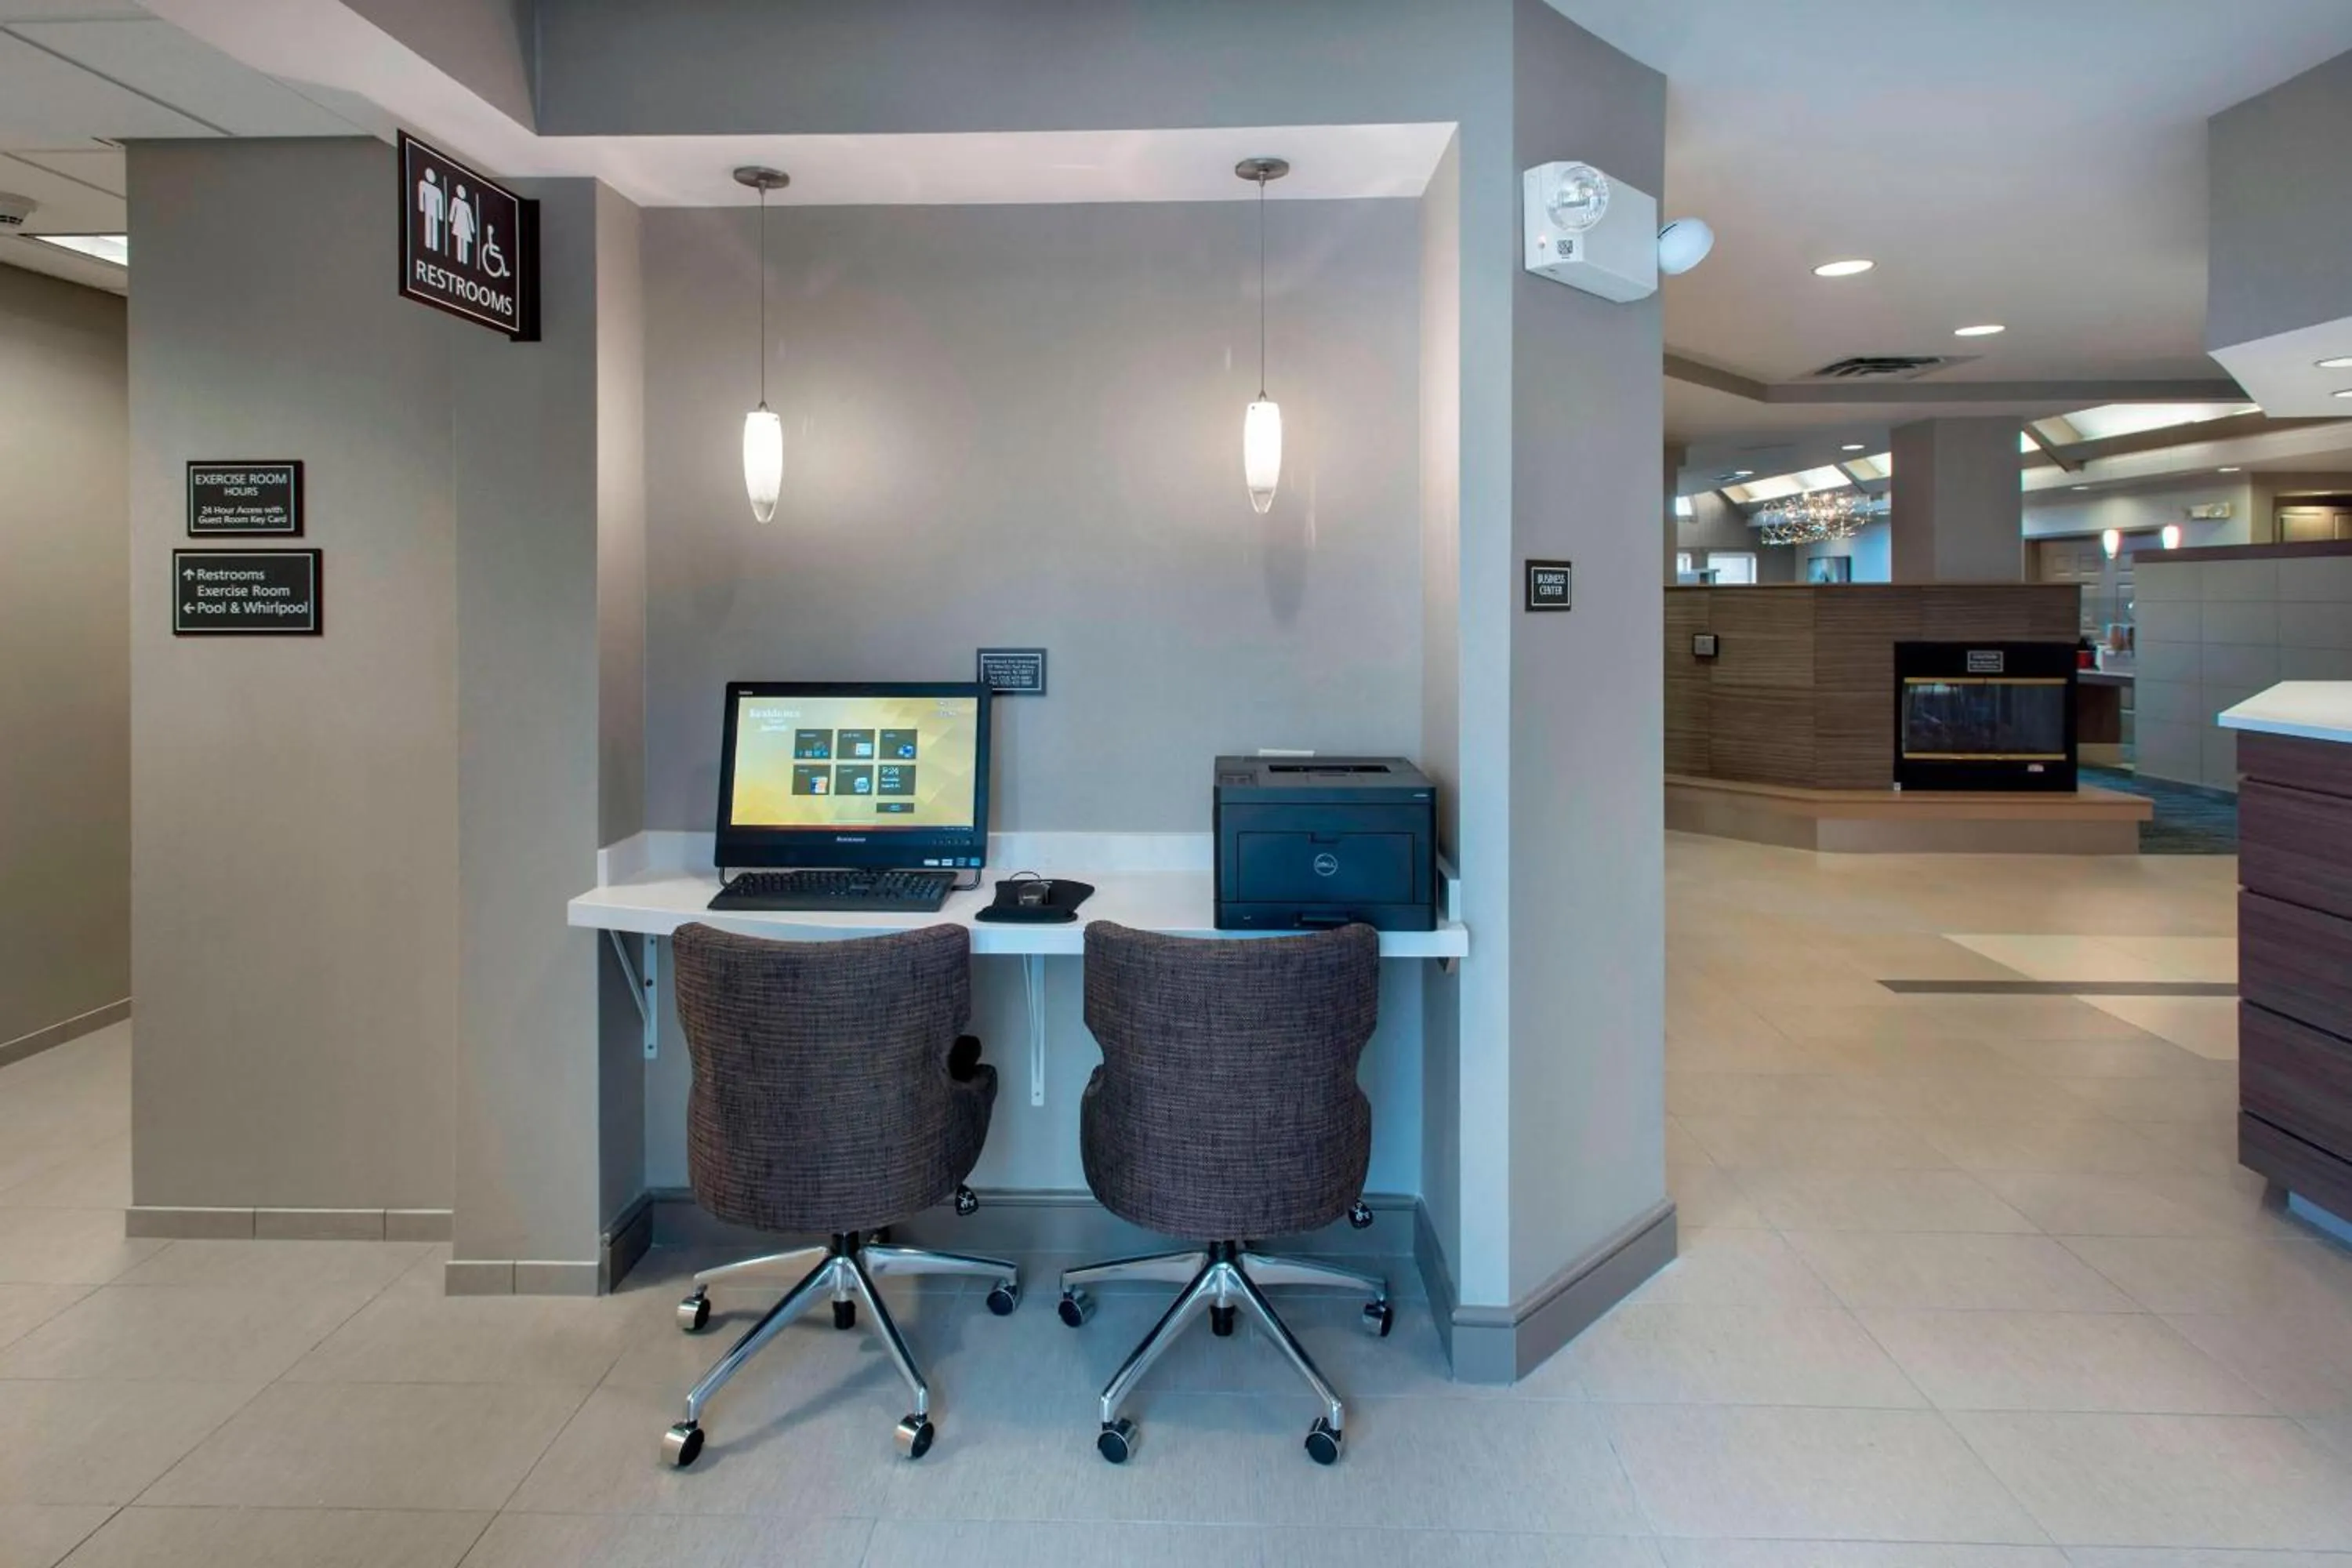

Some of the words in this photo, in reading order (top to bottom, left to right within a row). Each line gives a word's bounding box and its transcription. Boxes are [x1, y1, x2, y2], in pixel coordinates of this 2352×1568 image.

[416, 260, 513, 315] RESTROOMS
[195, 474, 247, 485] EXERCISE
[249, 474, 288, 485] ROOM
[224, 487, 259, 496] HOURS
[201, 506, 212, 514] 24
[214, 506, 234, 514] Hour
[237, 506, 263, 514] Access
[264, 506, 284, 514] with
[198, 515, 222, 524] Guest
[223, 515, 249, 524] Room
[250, 515, 266, 524] Key
[267, 514, 287, 523] Card
[197, 568, 266, 580] Restrooms
[1537, 574, 1566, 584] BUSINESS
[198, 585, 249, 597] Exercise
[252, 585, 291, 597] Room
[1539, 586, 1563, 595] CENTER
[198, 602, 227, 614] Pool
[230, 601, 241, 614] &
[242, 601, 309, 616] Whirlpool
